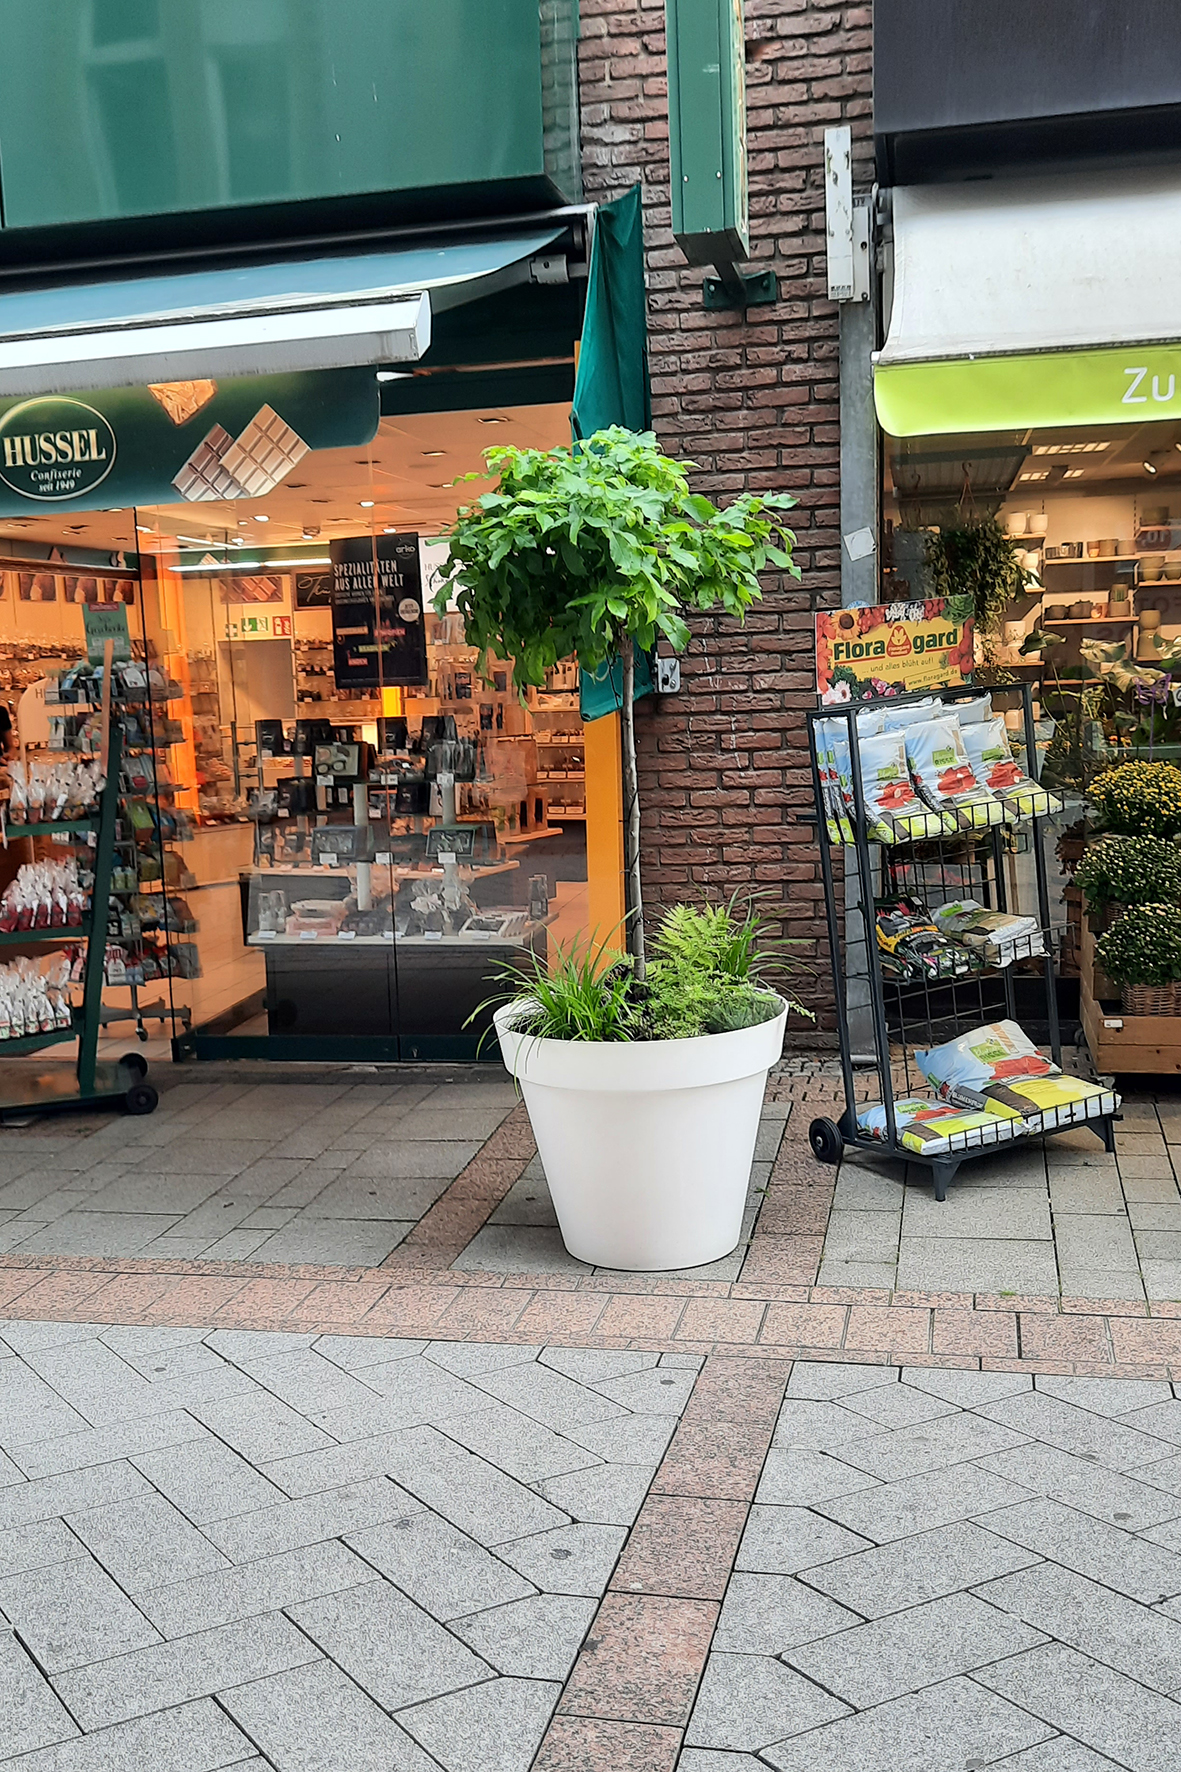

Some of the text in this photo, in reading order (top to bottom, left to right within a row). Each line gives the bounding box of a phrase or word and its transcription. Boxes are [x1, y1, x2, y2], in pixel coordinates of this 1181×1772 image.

[1121, 366, 1176, 404] Zu
[3, 428, 107, 467] HUSSEL
[30, 467, 82, 482] Confiserie
[38, 480, 77, 493] seit 1949
[395, 545, 416, 554] arko
[334, 577, 350, 591] AUS
[381, 573, 404, 589] WELT
[833, 640, 886, 661] Flora
[912, 628, 958, 655] gard
[870, 663, 884, 672] und
[884, 662, 900, 671] alles
[901, 658, 919, 668] blüht
[908, 668, 958, 686] www.floragard.de
